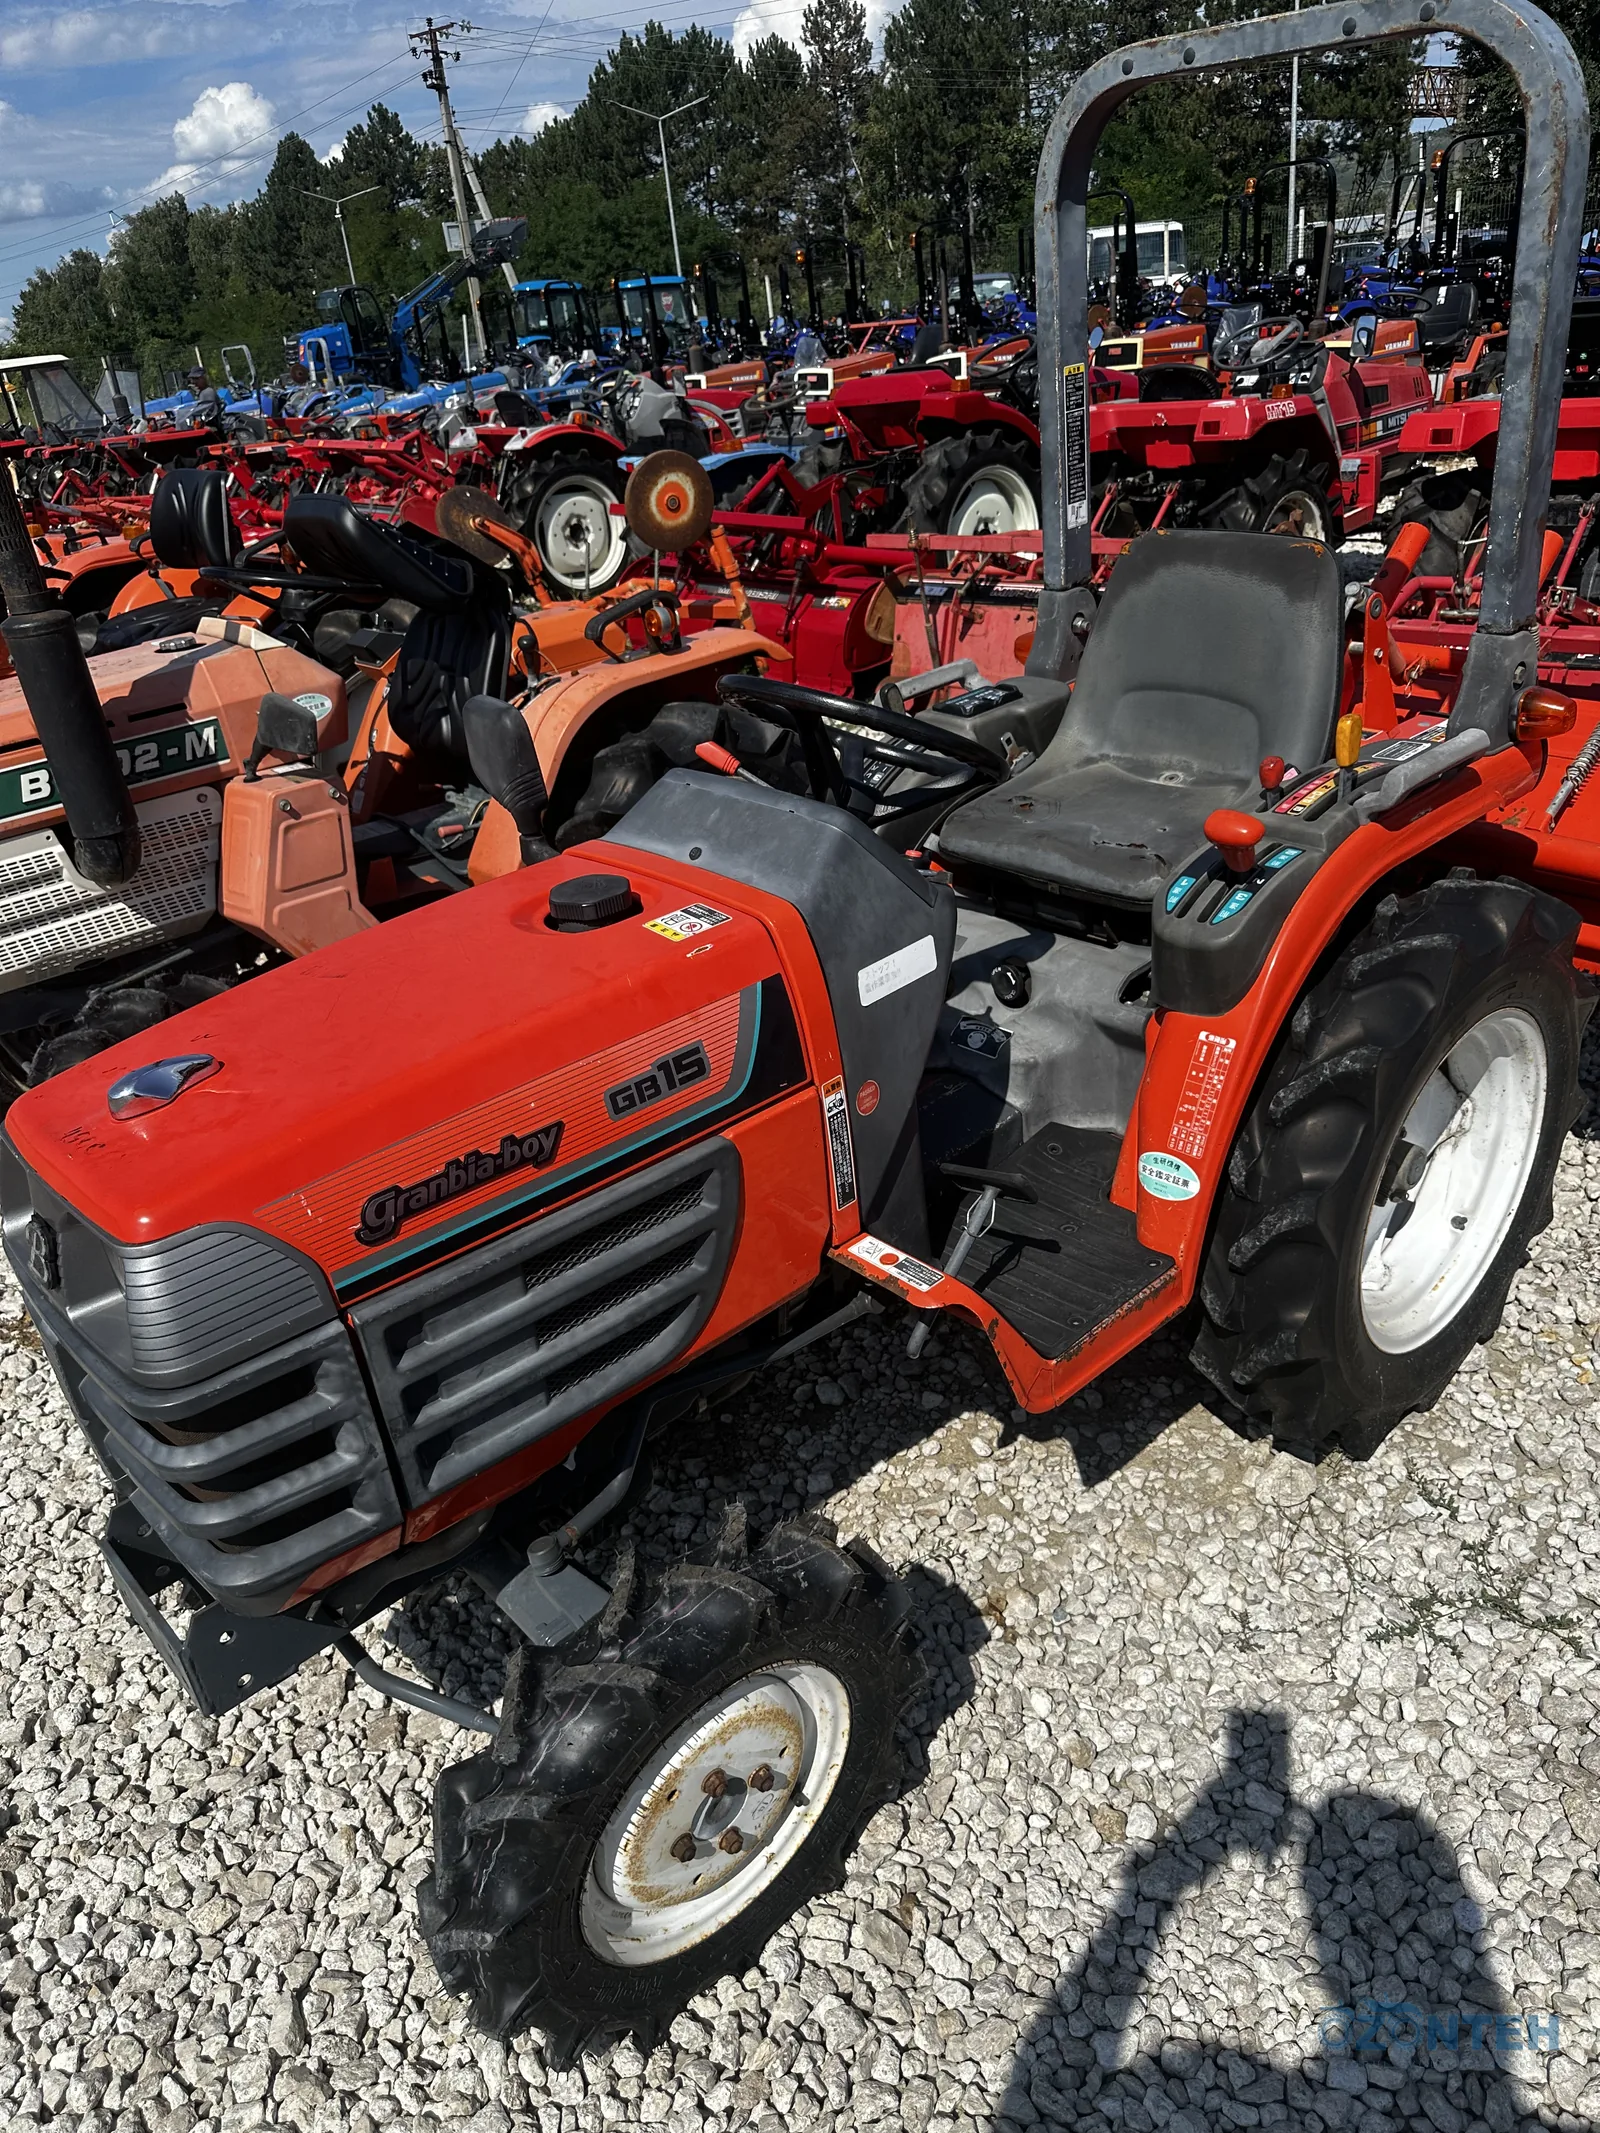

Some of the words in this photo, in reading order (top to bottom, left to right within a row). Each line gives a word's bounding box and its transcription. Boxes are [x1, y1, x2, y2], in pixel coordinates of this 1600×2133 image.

[1170, 341, 1197, 349] YANMAR
[1384, 339, 1410, 351] YANMAR
[608, 1045, 707, 1116] GB15
